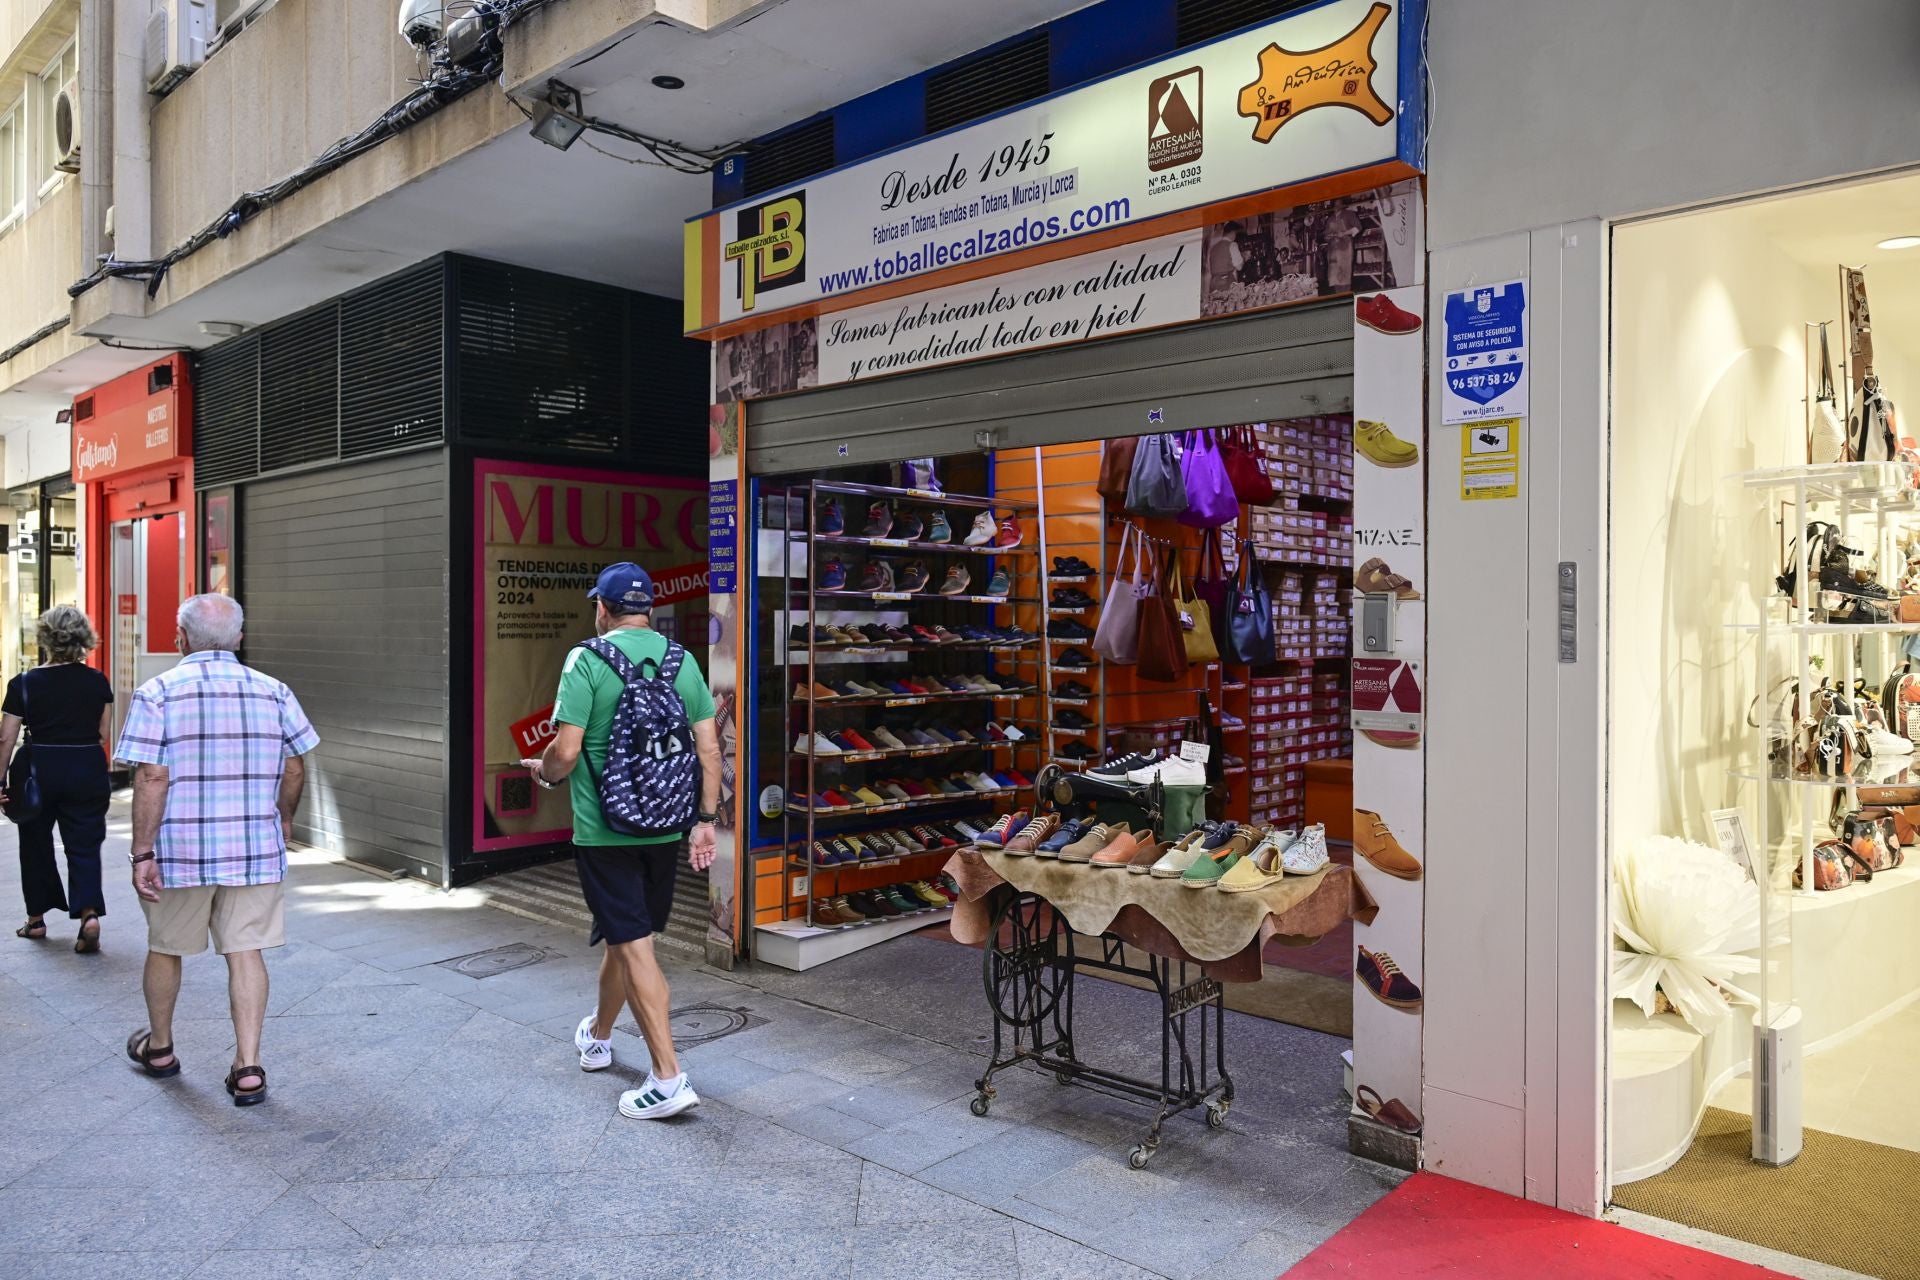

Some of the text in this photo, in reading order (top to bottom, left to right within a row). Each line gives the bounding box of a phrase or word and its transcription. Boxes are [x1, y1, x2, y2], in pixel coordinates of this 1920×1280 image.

[1265, 101, 1291, 120] TB
[1149, 127, 1202, 152] ARTESANÍA
[1171, 145, 1179, 153] DE
[1180, 140, 1202, 151] MURCIA
[1148, 148, 1202, 166] murciartesana.es
[880, 132, 1055, 211] Desde 1945
[1181, 165, 1202, 179] 0303
[1148, 177, 1202, 195] CUERO LEATHER
[873, 173, 1074, 245] Fabrica en Totana, tiendas en Totana, Murcia y Lorca
[819, 197, 1130, 294] www.toballecalzados.com
[825, 245, 1186, 347] Somos fabricantes con calidad
[848, 293, 1148, 382] y comodidad todo en piel
[1453, 332, 1476, 342] SISTEMA
[1485, 326, 1516, 337] SEGURIDAD
[1469, 340, 1485, 349] AVISO
[1453, 371, 1516, 390] 96 537 58 24
[1463, 405, 1505, 416] www.tjjarc.es
[497, 560, 588, 574] TENDENCIAS
[497, 574, 598, 590] OTOÑO/INVIE
[497, 592, 535, 604] 2024
[497, 611, 578, 620] Aprovecha todas las
[497, 622, 550, 630] promociones
[497, 631, 532, 639] tenemos
[535, 632, 553, 640] para
